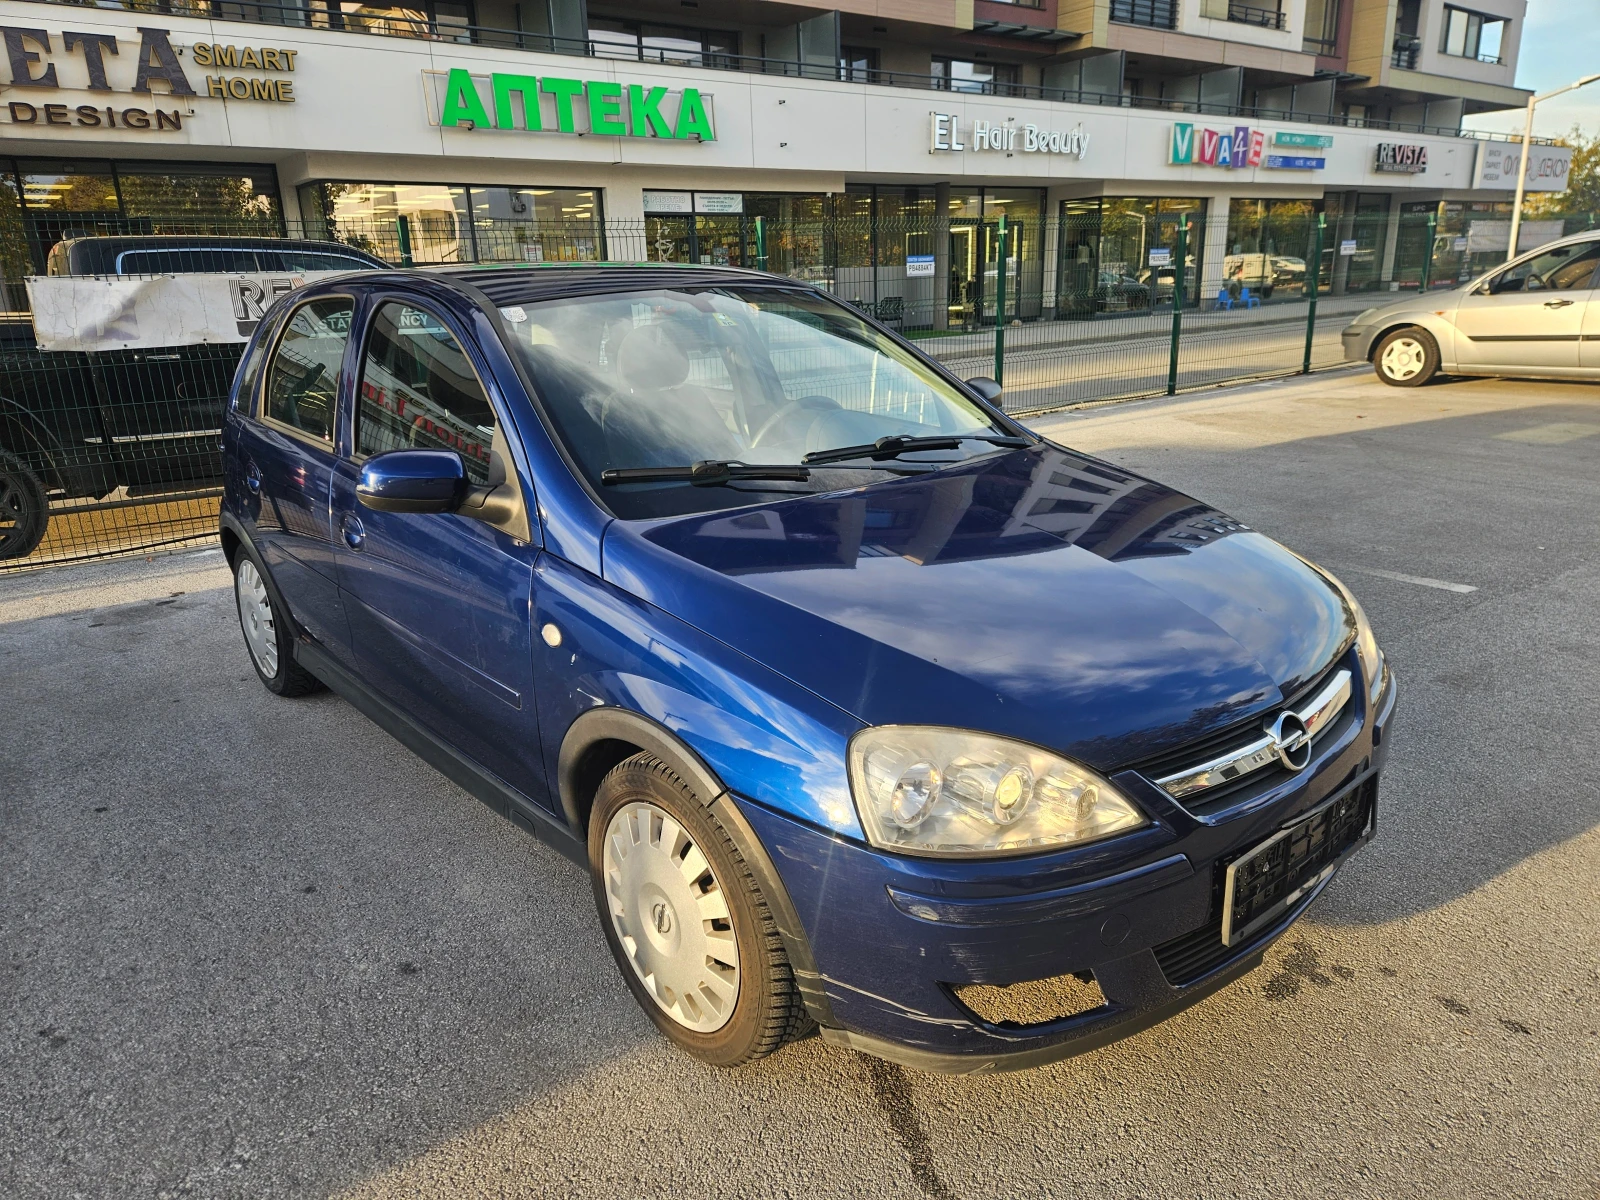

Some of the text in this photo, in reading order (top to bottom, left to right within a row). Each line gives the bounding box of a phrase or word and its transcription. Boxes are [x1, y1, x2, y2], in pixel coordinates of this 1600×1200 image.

[193, 42, 298, 72] SMART
[206, 75, 296, 102] HOME
[8, 101, 182, 131] DESIGN
[441, 68, 715, 141] АПТЕКА
[932, 113, 1090, 160] EL Hair Beauty
[1380, 143, 1428, 166] REVISTA
